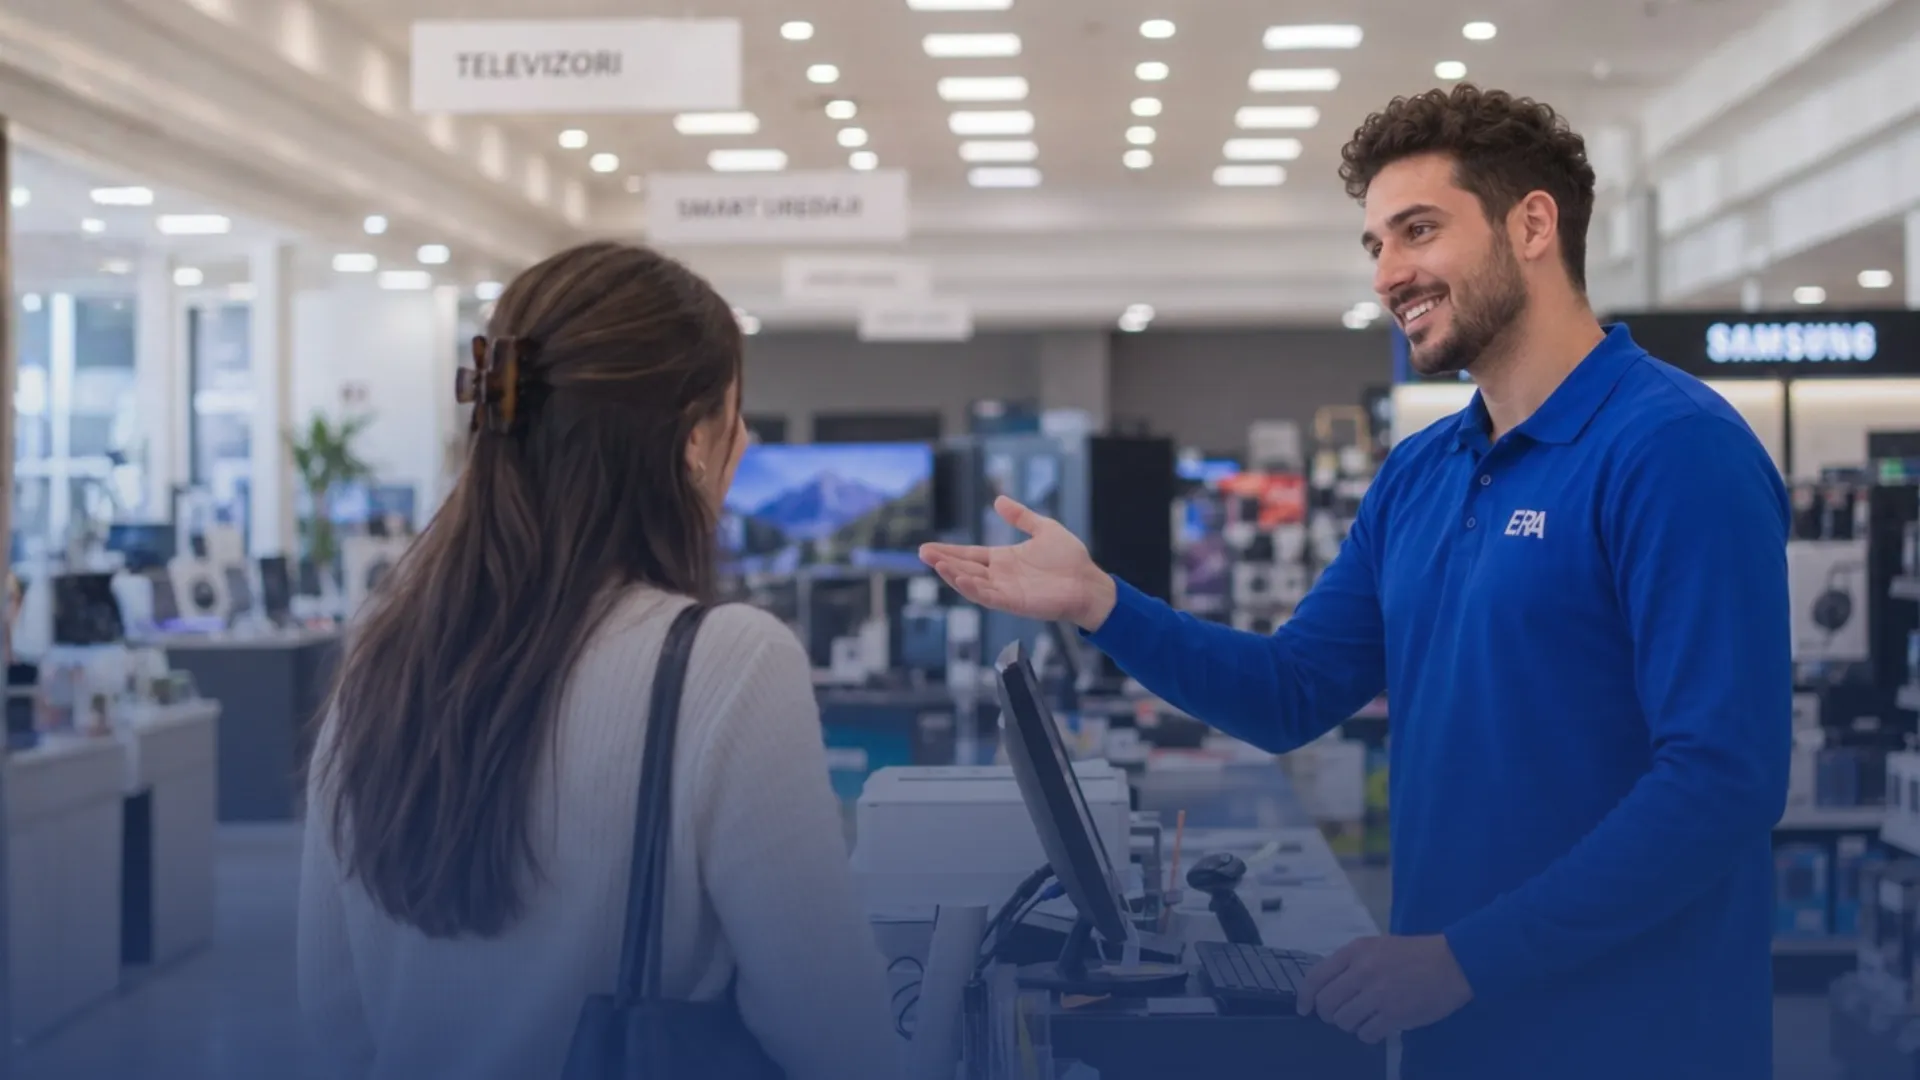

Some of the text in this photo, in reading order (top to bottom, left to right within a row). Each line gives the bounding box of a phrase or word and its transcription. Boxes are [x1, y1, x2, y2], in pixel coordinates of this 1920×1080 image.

[456, 51, 624, 78] TELEVIZORI
[677, 196, 757, 219] SMART
[1706, 322, 1876, 363] SAMSUNG
[1504, 509, 1546, 539] ERA
